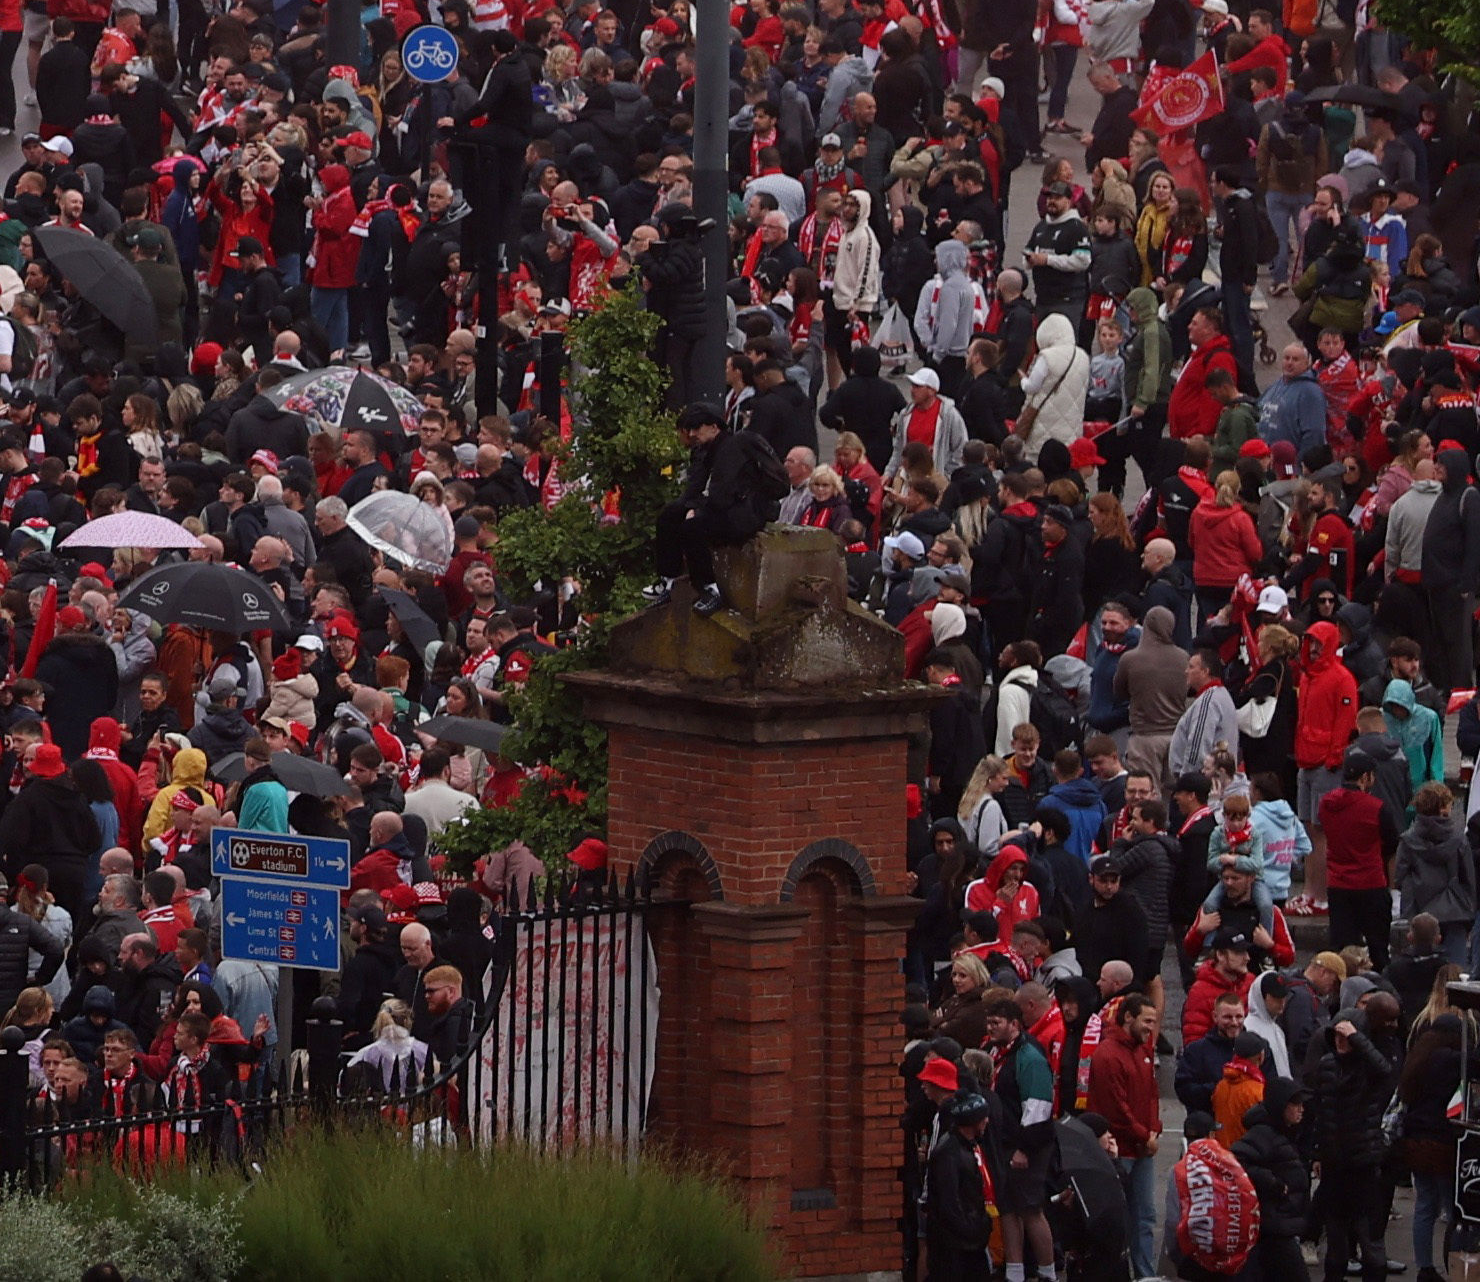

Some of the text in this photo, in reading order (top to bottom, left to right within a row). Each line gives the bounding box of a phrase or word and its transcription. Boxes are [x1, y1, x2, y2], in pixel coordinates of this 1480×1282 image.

[250, 843, 306, 859] Everton F.C.
[261, 859, 297, 873] stadium
[246, 889, 289, 902] Moorfields
[248, 907, 272, 920] James
[274, 911, 283, 920] St
[247, 925, 265, 936] Lime
[268, 927, 277, 938] St
[248, 944, 278, 956] Central
